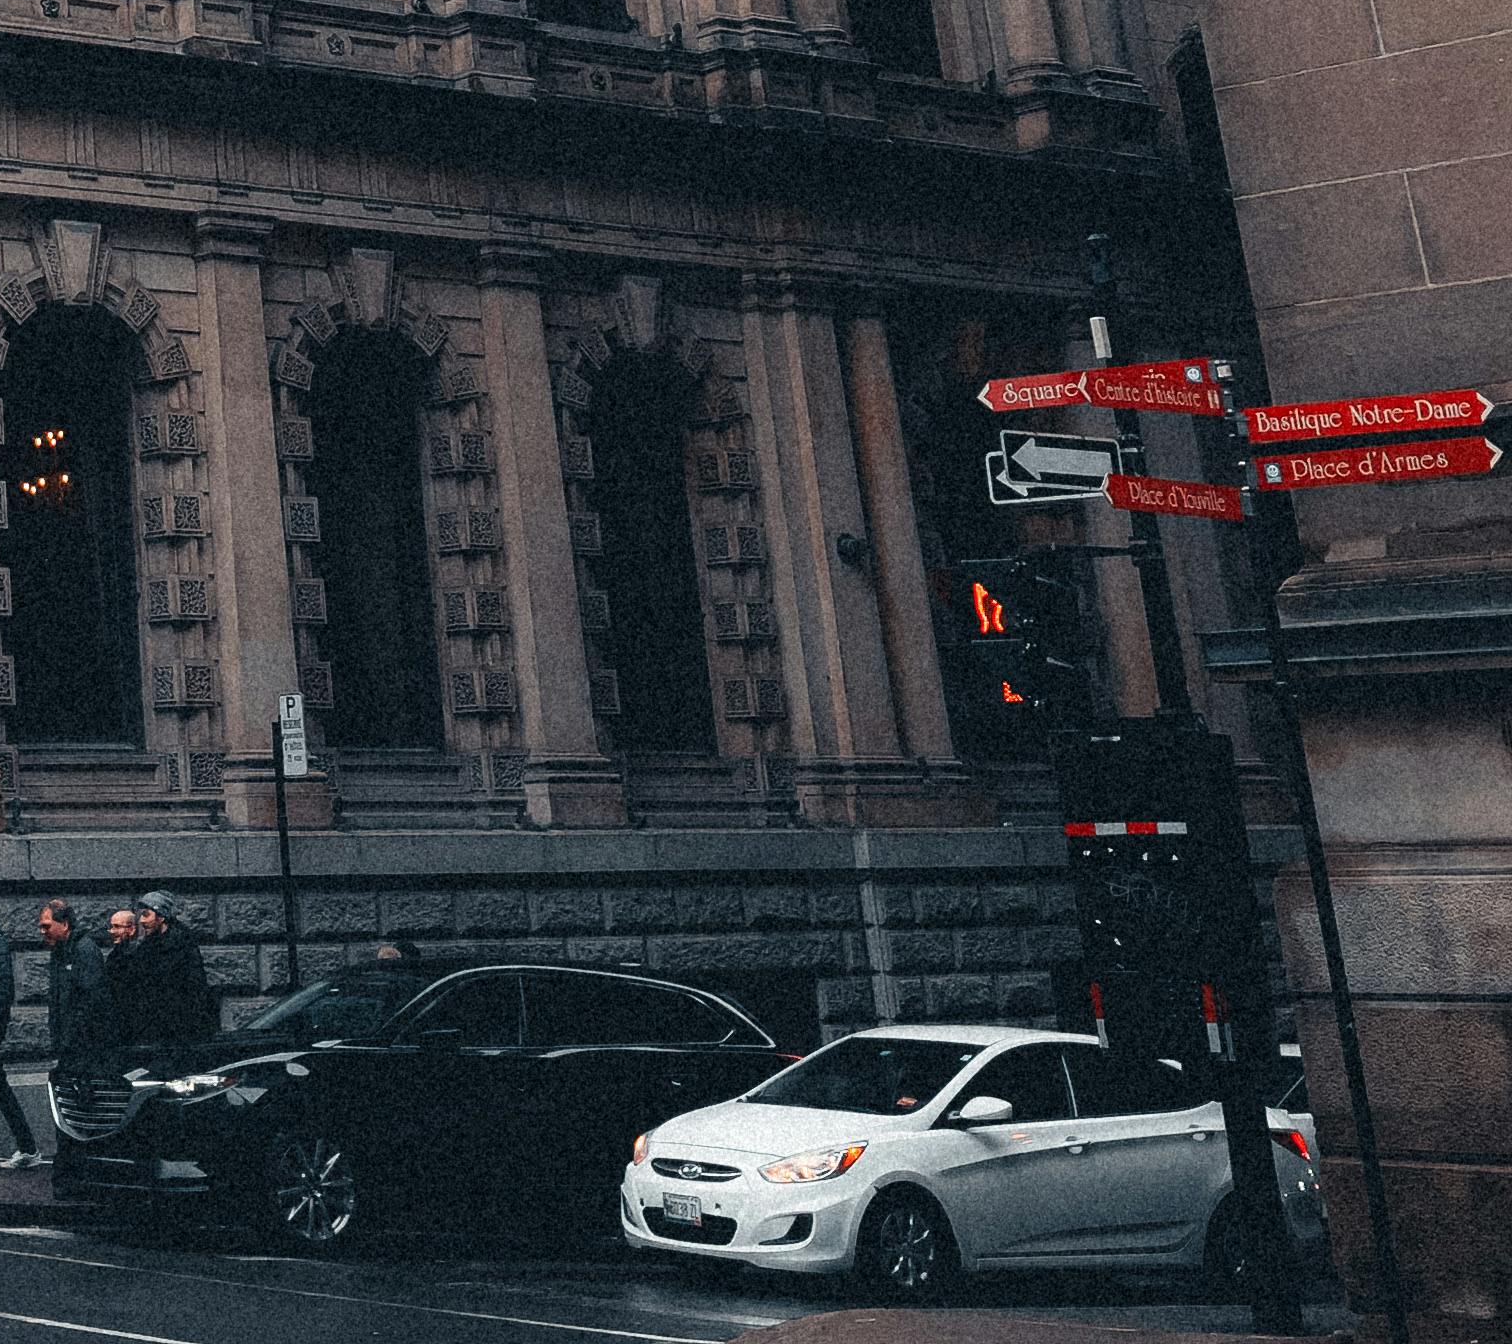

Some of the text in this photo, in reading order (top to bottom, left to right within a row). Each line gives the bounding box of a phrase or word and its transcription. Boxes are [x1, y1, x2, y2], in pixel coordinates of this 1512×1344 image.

[1002, 382, 1079, 408] Square
[1094, 378, 1201, 409] Centre d'histoire
[1255, 399, 1473, 435] Basilique Notre-Dame
[1290, 451, 1449, 481] Place d'Armes
[1127, 481, 1226, 513] Place d'Youville
[285, 696, 296, 719] P
